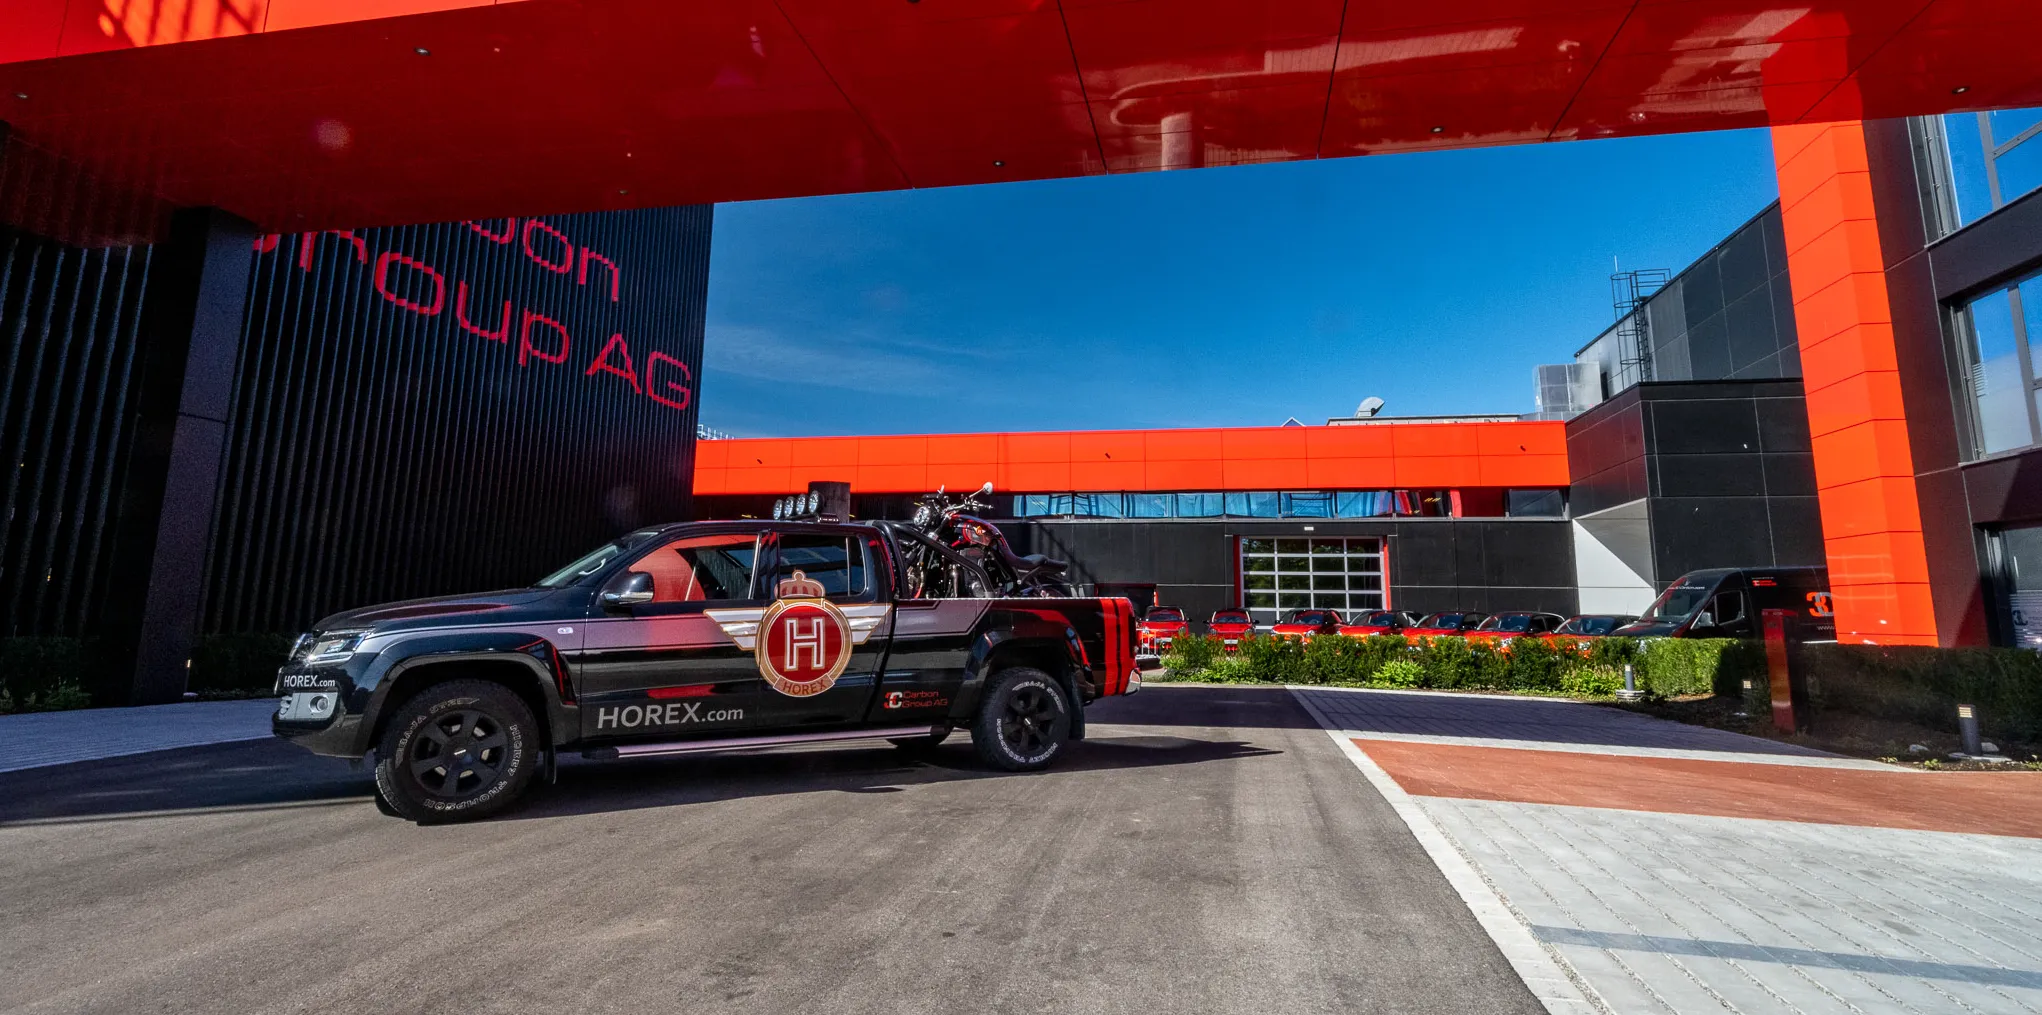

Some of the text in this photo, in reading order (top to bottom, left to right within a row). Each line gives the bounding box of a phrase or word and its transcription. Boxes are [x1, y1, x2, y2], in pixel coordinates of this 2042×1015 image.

[586, 333, 691, 410] AG
[784, 616, 826, 672] H
[283, 674, 336, 688] HOREX.com
[782, 679, 827, 695] HOREX
[903, 690, 939, 698] Carbon
[901, 698, 949, 708] Group AG
[597, 702, 744, 729] HOREX.com
